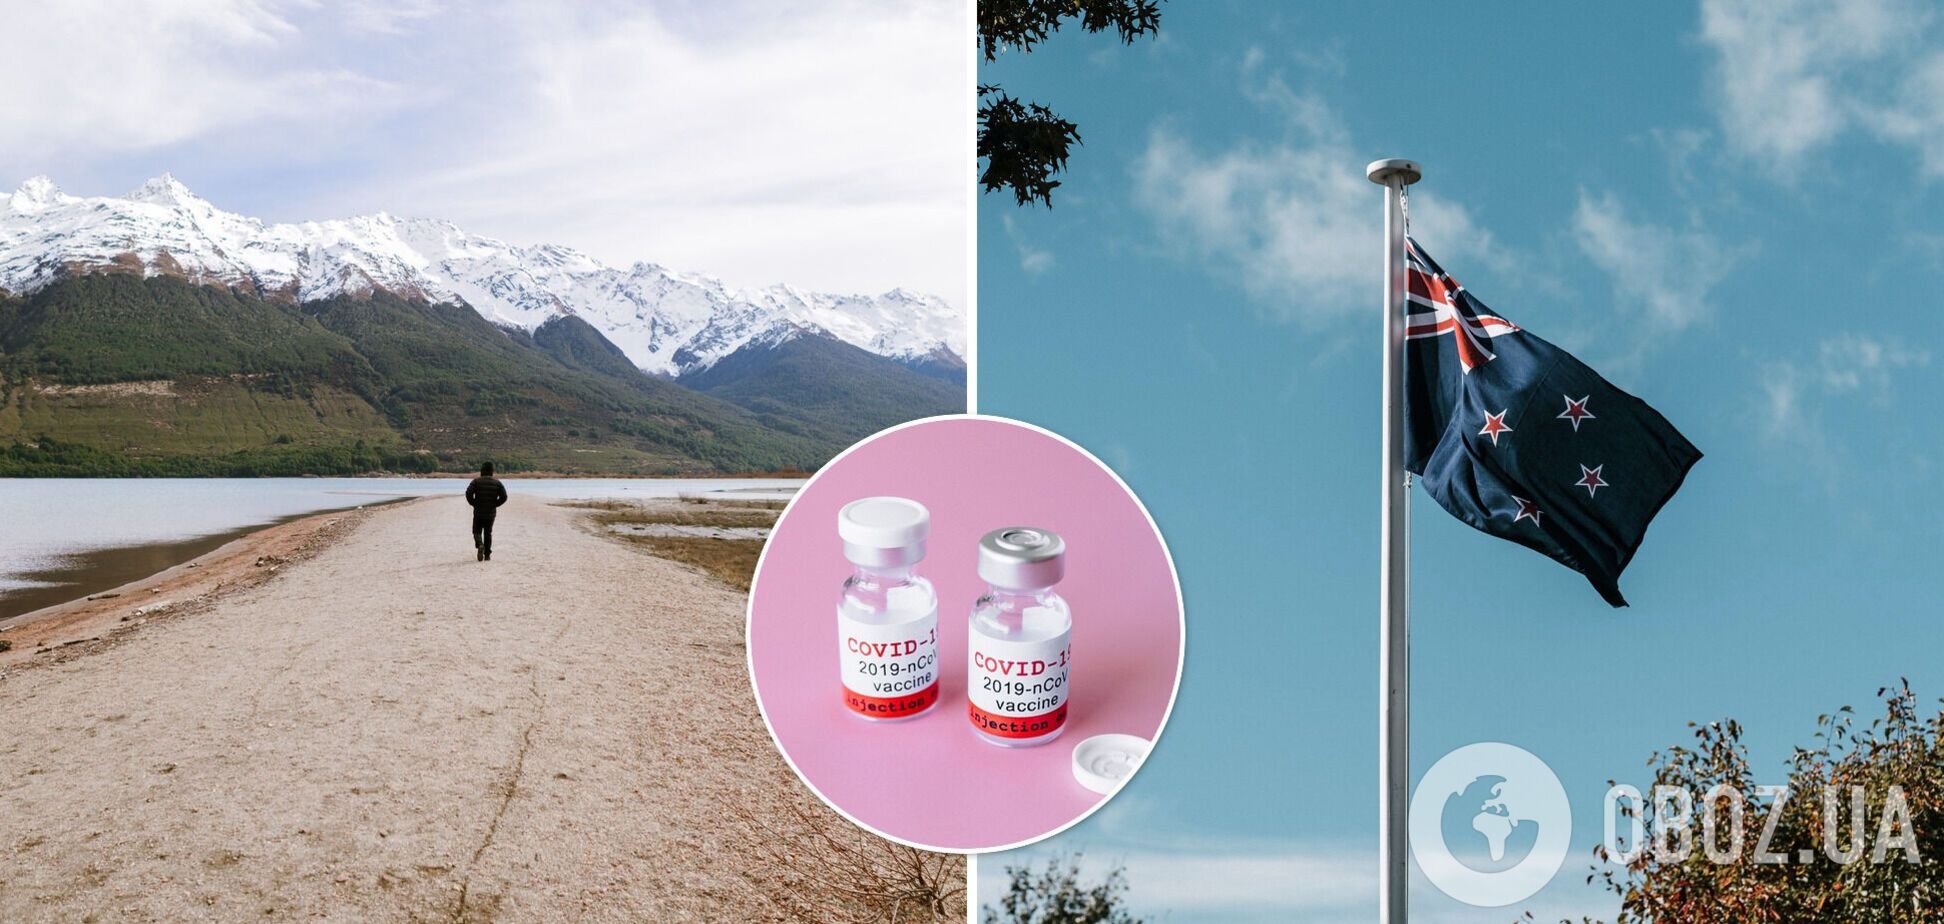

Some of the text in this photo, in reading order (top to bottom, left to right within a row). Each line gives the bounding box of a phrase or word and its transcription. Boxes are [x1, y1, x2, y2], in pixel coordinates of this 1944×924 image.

[873, 672, 932, 693] vaccine
[983, 668, 1069, 696] 2019-nCoV
[847, 695, 925, 712] injection
[996, 695, 1059, 712] vaccine
[970, 707, 1048, 733] injection
